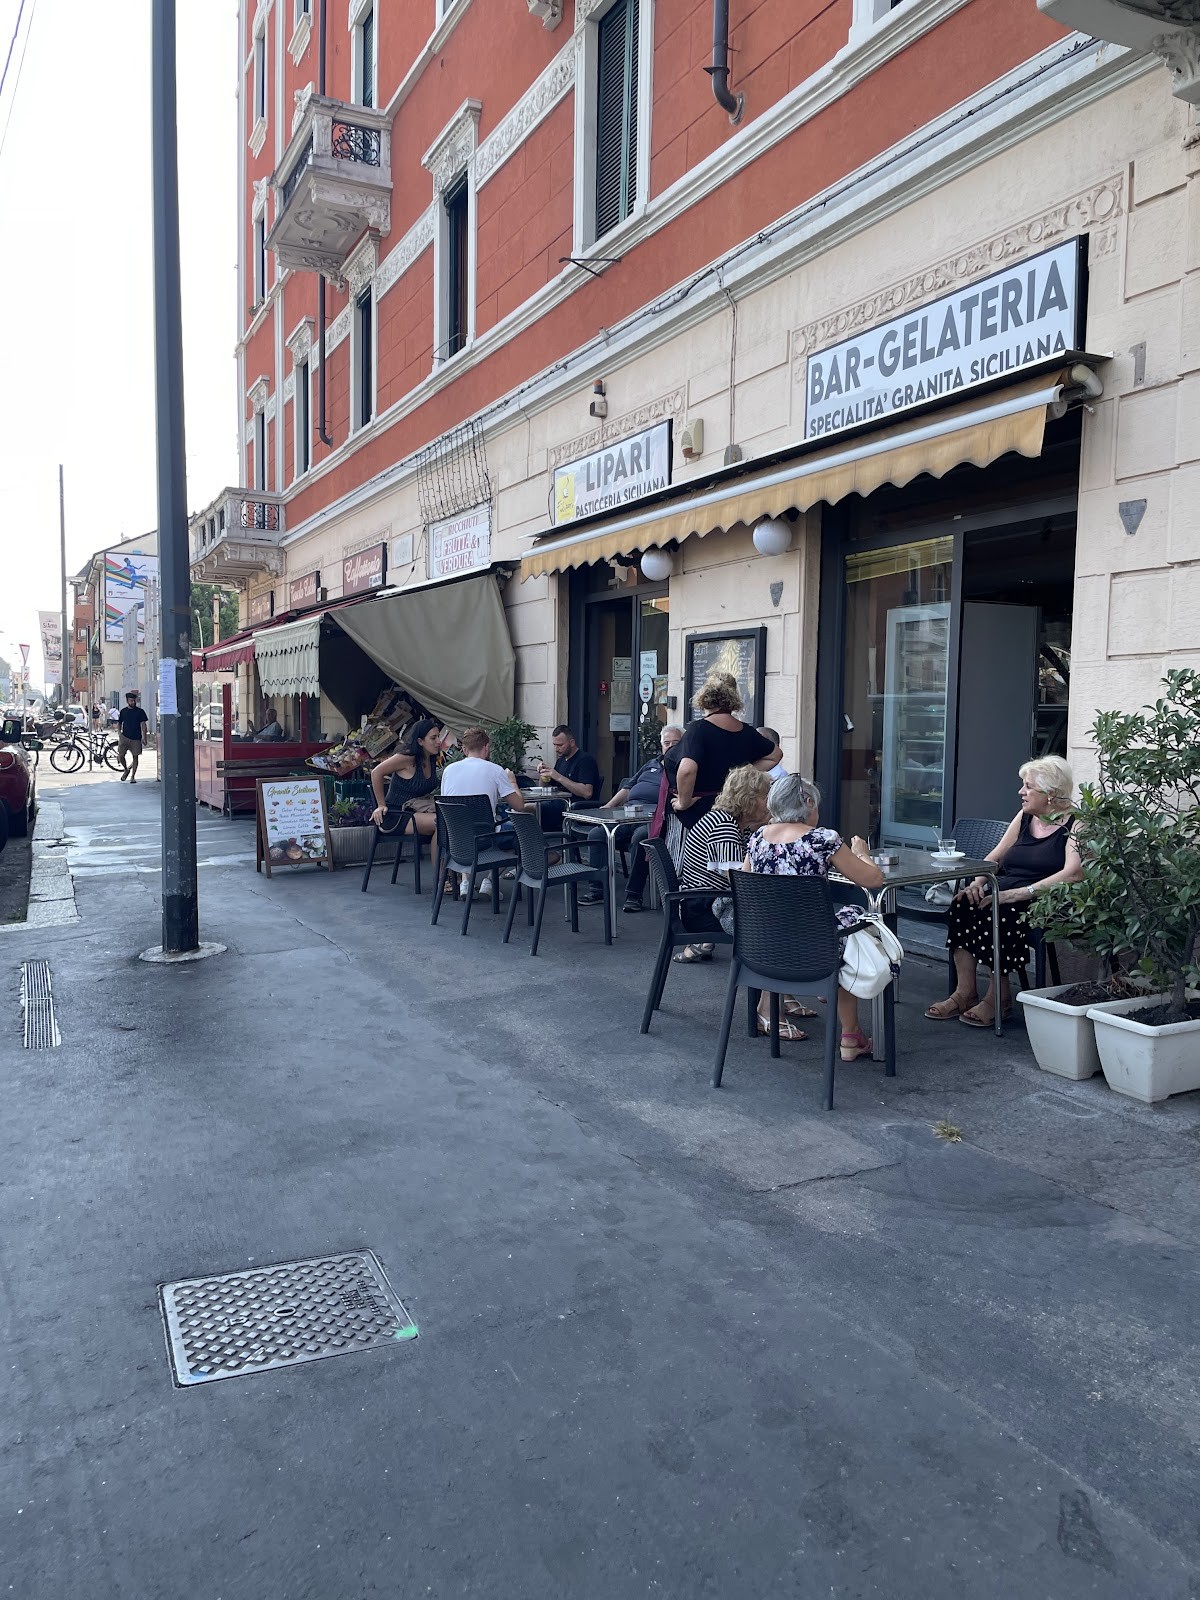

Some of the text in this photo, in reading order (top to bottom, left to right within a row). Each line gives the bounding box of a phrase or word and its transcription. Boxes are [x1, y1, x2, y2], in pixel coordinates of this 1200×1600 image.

[810, 260, 1068, 406] BAR-GELATERIA
[892, 369, 964, 409] GRANITA
[970, 331, 1067, 382] SICILIANA
[586, 436, 651, 492] LIPARI
[575, 494, 622, 518] PASTICCERIA
[624, 476, 665, 502] SICILIANA
[440, 550, 475, 574] VERDURA
[443, 533, 477, 556] FRUTTA &
